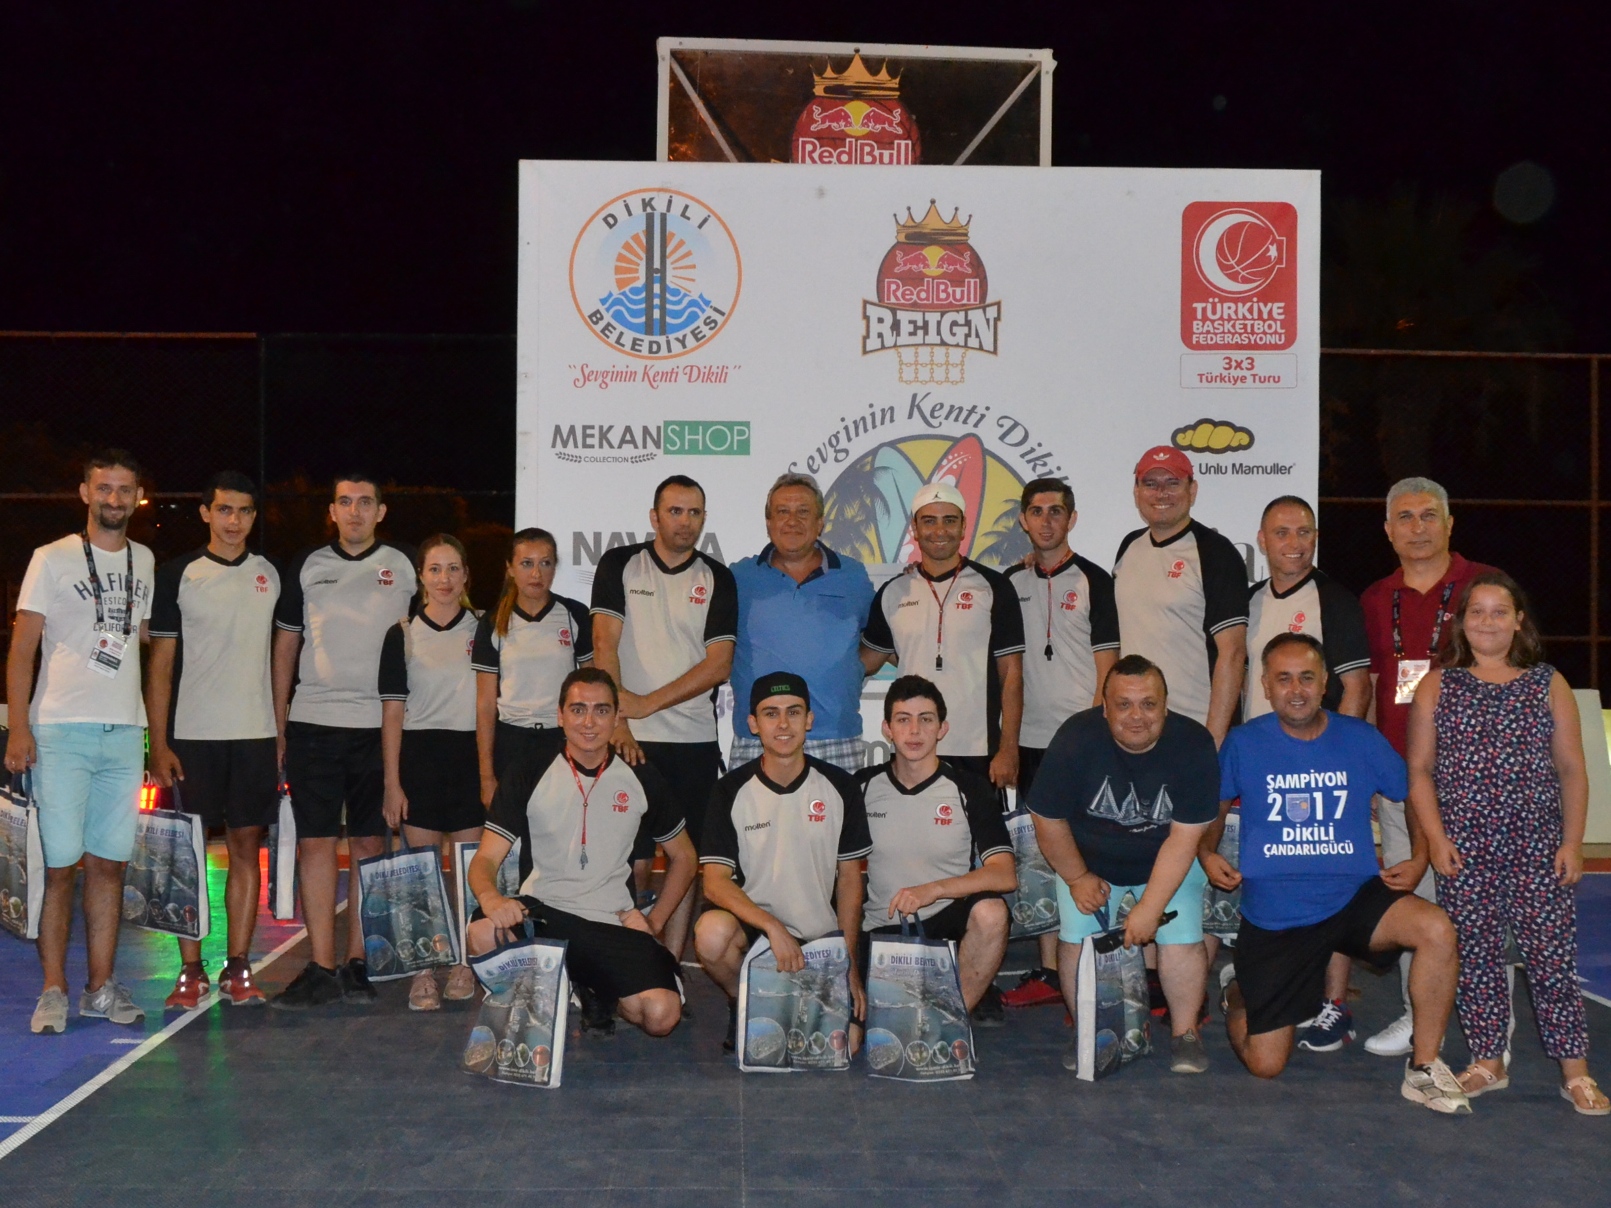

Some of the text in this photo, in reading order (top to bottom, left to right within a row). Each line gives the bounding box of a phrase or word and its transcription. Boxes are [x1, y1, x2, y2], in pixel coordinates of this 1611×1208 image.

[602, 195, 711, 231] DİKİLİ
[1192, 297, 1286, 319] TÜRKİYE
[587, 304, 727, 355] BELEDİYESİ
[865, 302, 999, 350] REIGN
[1192, 319, 1286, 333] BASKETBOL
[1192, 333, 1286, 345] FEDERASYONU
[1222, 356, 1255, 371] 3x3
[641, 364, 679, 384] Kenti
[1197, 371, 1281, 386] Türkiye Turu
[907, 392, 991, 429] Kenti
[996, 415, 1069, 481] Diki
[583, 456, 629, 464] COLLECTION
[1199, 463, 1228, 475] Unlu
[1232, 463, 1294, 475] Mamuller
[1168, 570, 1181, 579] TBF
[73, 572, 150, 602] HLFIER
[255, 585, 268, 593] TBF
[103, 596, 141, 609] ESTCOST
[629, 588, 706, 605] molten TBF
[956, 602, 973, 610] TBF
[1060, 602, 1076, 611] TBF
[93, 622, 138, 634] CLIFOA
[770, 684, 791, 693] CELTICS
[1266, 769, 1348, 793] ŞAMPİYON
[612, 804, 629, 813] TBF
[744, 814, 826, 832] molten TBF
[934, 817, 953, 826] TBF
[1010, 823, 1035, 836] LEDİYES
[1282, 823, 1334, 842] DİKİLİ
[1263, 840, 1354, 858] ÇANDARLIGÜCÜ
[804, 946, 832, 960] EDİYESİ
[890, 953, 912, 965] DİKİLİ
